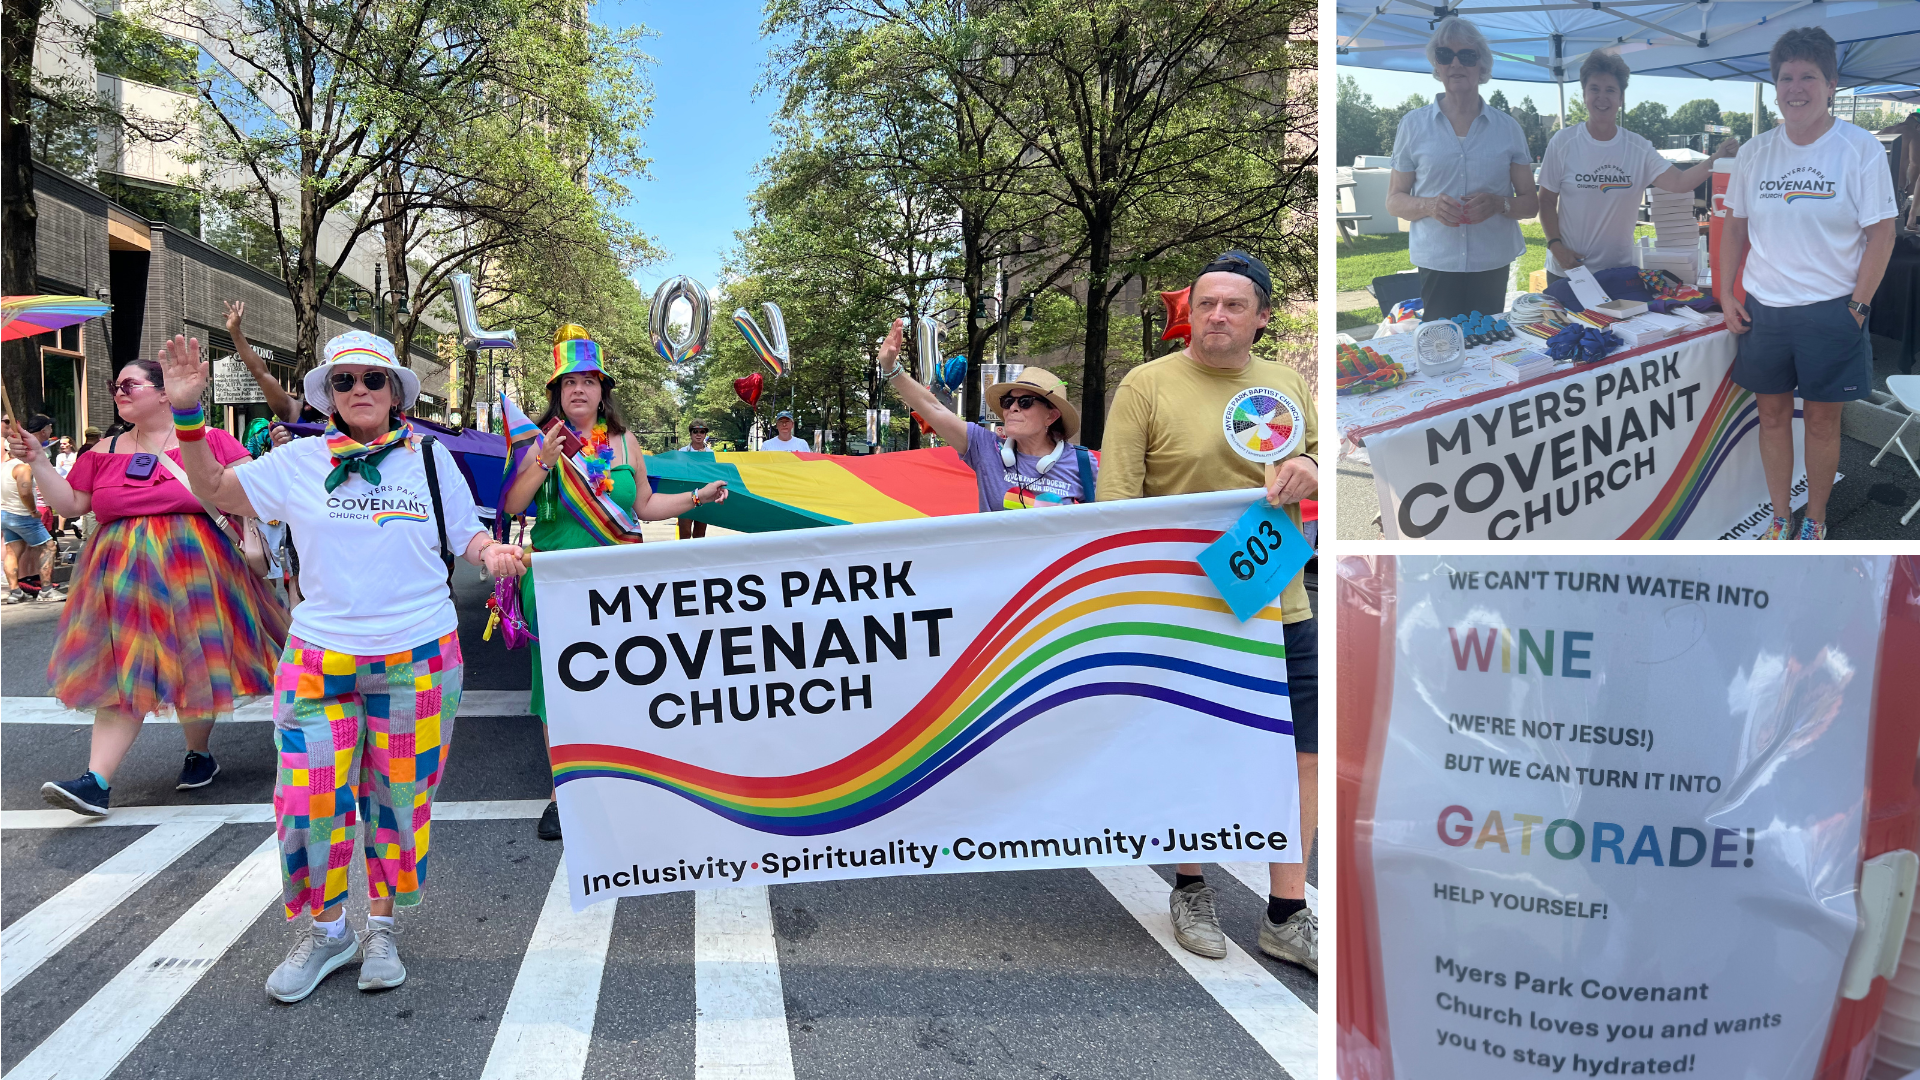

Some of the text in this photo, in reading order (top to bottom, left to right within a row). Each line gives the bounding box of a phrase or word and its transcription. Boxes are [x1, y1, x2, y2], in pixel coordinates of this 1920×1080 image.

[1575, 174, 1631, 183] COVENANT
[1594, 164, 1625, 174] MYERS PARK
[1760, 180, 1835, 193] COVENANT
[1781, 166, 1825, 180] MYERS PARK
[1225, 388, 1300, 431] MYERS PARK BAPTIST CHURCH
[1425, 351, 1681, 466] MYERS PARK
[1046, 479, 1072, 490] DOESN'T
[1398, 382, 1701, 539] COVENANT
[326, 497, 428, 514] COVENANT
[329, 512, 369, 520] CHURCH
[1487, 446, 1655, 540] CHURCH
[1229, 520, 1282, 581] 603
[588, 560, 916, 626] MYERS PARK
[1448, 571, 1769, 610] WE CAN'T TURN WATER INTO
[557, 607, 953, 692] COVENANT
[1448, 626, 1594, 679] WINE
[648, 674, 873, 729] CHURCH
[1448, 713, 1655, 752] (WE'RE NOT JESUS!)
[1444, 752, 1722, 795] BUT WE CAN TURN IT INTO
[583, 823, 1288, 896] Inclusivity Spirituality Community Justice
[1436, 804, 1755, 869] GATORADE!
[1433, 883, 1609, 921] HELP YOURSELF!
[1435, 955, 1710, 1004] Myers Park Covenant
[1435, 991, 1783, 1044] Church loves you and wants
[1436, 1027, 1697, 1078] you to stay hydrated!
